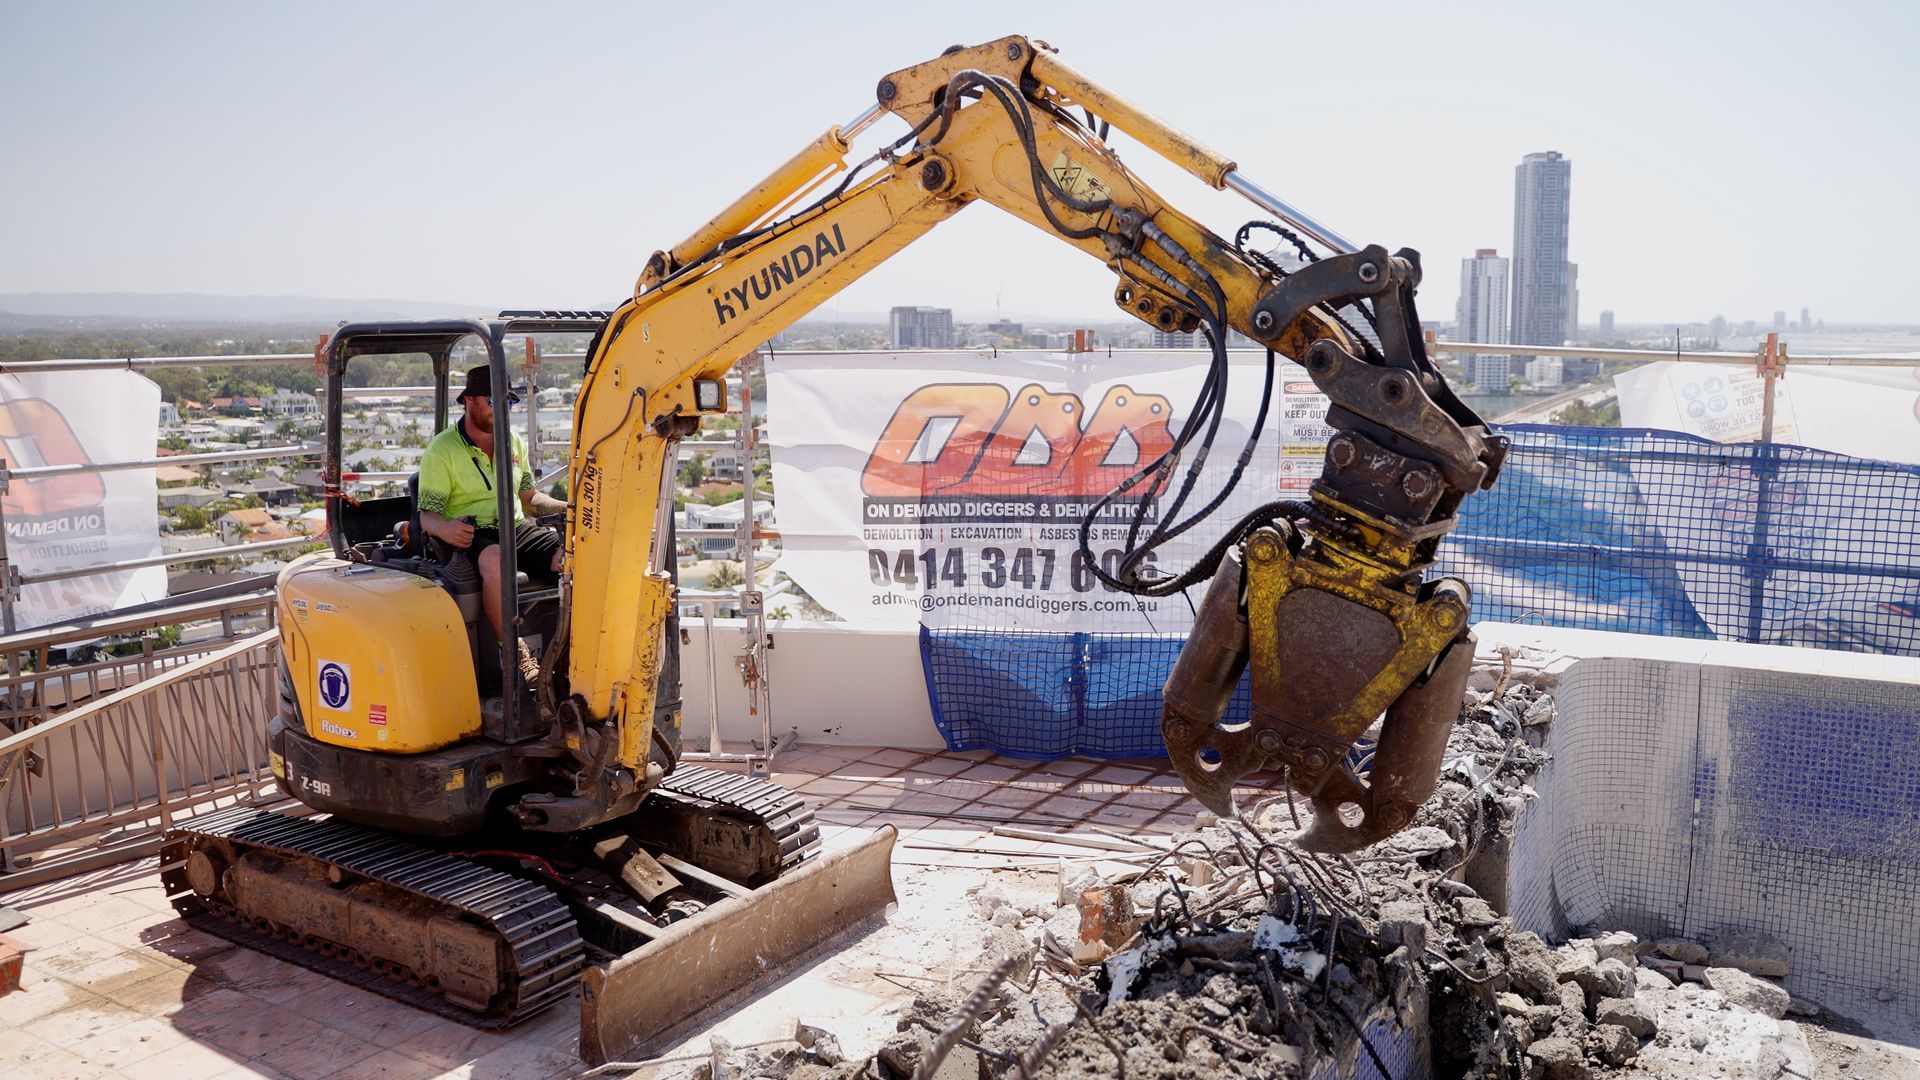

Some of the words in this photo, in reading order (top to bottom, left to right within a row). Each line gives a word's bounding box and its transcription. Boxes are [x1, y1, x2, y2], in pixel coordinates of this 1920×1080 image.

[713, 223, 847, 326] HYUNDAI
[1284, 410, 1307, 419] KEEP
[1310, 410, 1327, 419] OUT
[1293, 429, 1318, 437] MUST
[1321, 429, 1334, 437] BE
[585, 466, 598, 482] Kg
[583, 481, 595, 504] 310
[582, 506, 594, 529] SWL
[866, 504, 890, 518] ON
[893, 503, 962, 518] DEMAND
[965, 502, 1036, 517] DIGGERS
[1039, 503, 1051, 517] &
[1055, 503, 1155, 518] DEMLITION
[863, 528, 933, 541] DEMOLITION
[950, 527, 1022, 539] EXCAVATION
[1102, 528, 1157, 541] REMVA
[868, 547, 967, 591] 0414
[981, 547, 1056, 591] 347
[872, 591, 1158, 613] admin@ondemanddiggers.com.au
[322, 719, 358, 739] Robex
